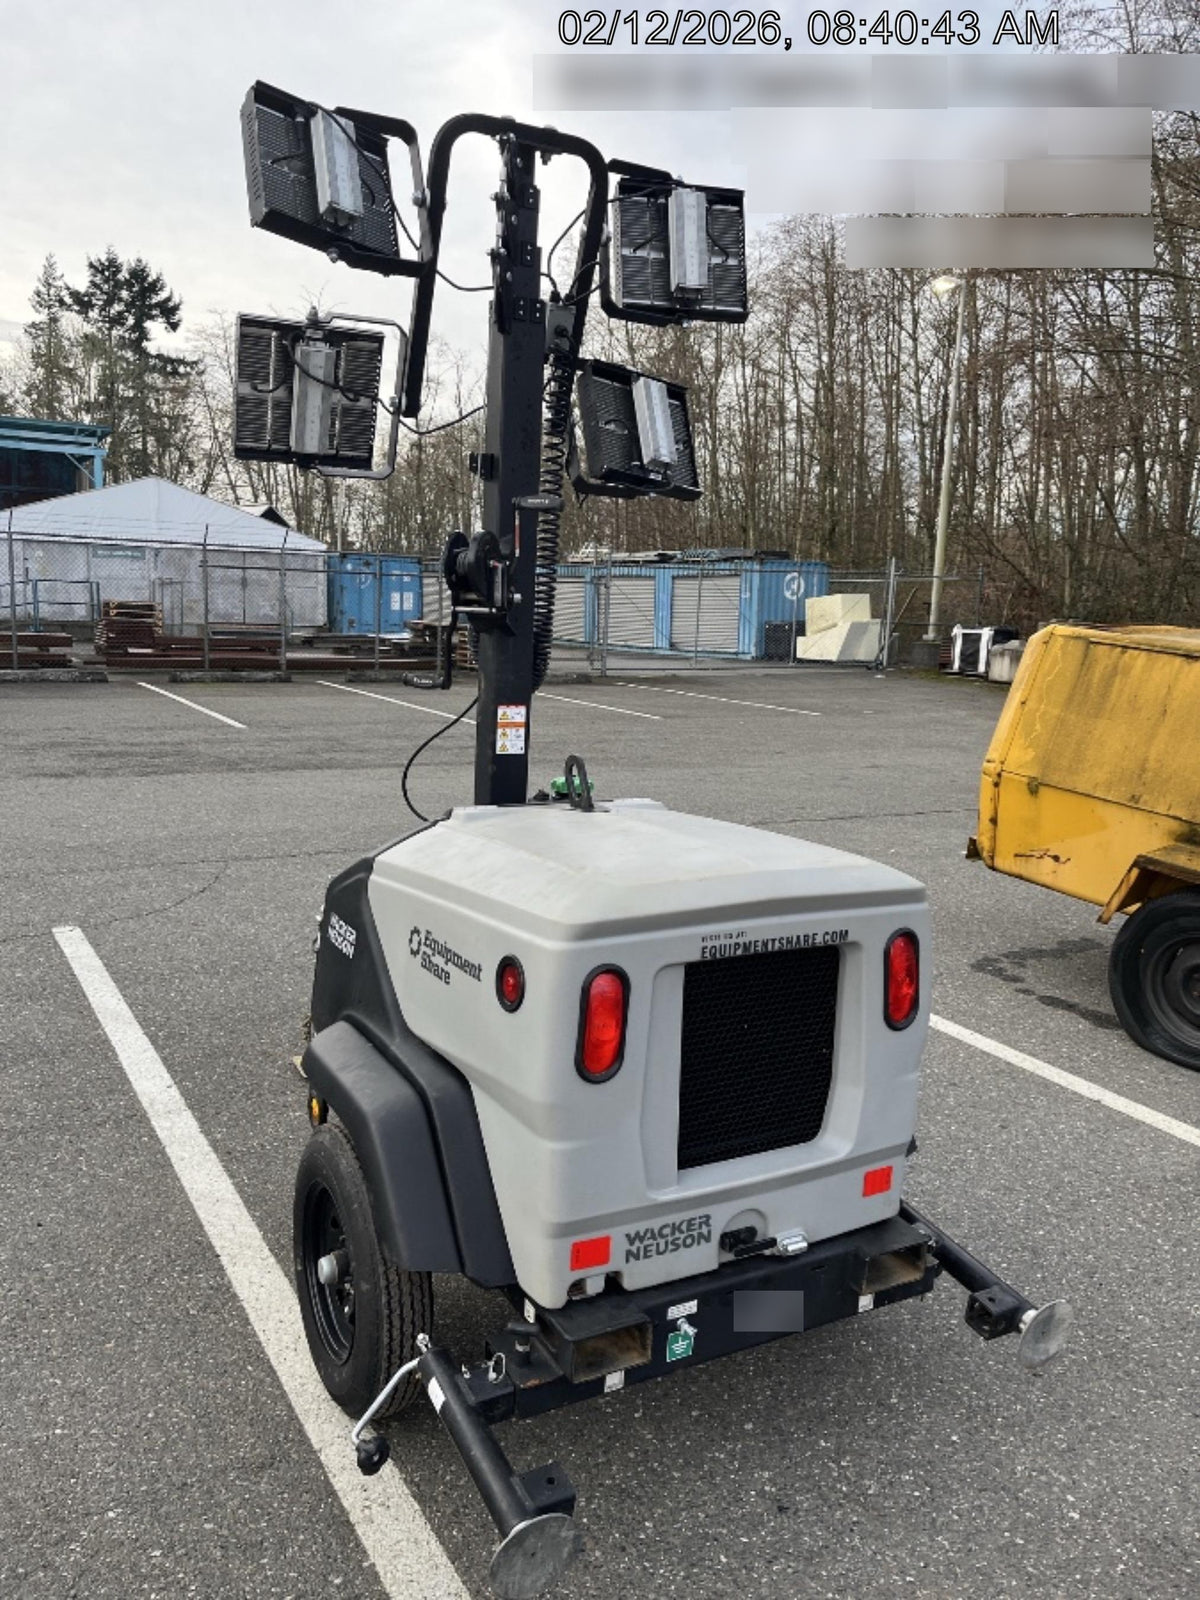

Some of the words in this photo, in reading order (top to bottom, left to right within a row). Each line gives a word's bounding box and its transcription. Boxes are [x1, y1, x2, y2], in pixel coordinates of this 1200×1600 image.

[423, 929, 482, 982] Equipment
[701, 929, 849, 959] EQUIPMENTSHARE.COM
[421, 950, 451, 985] Share
[625, 1213, 712, 1247] WACKER
[625, 1228, 712, 1264] NEUSON
